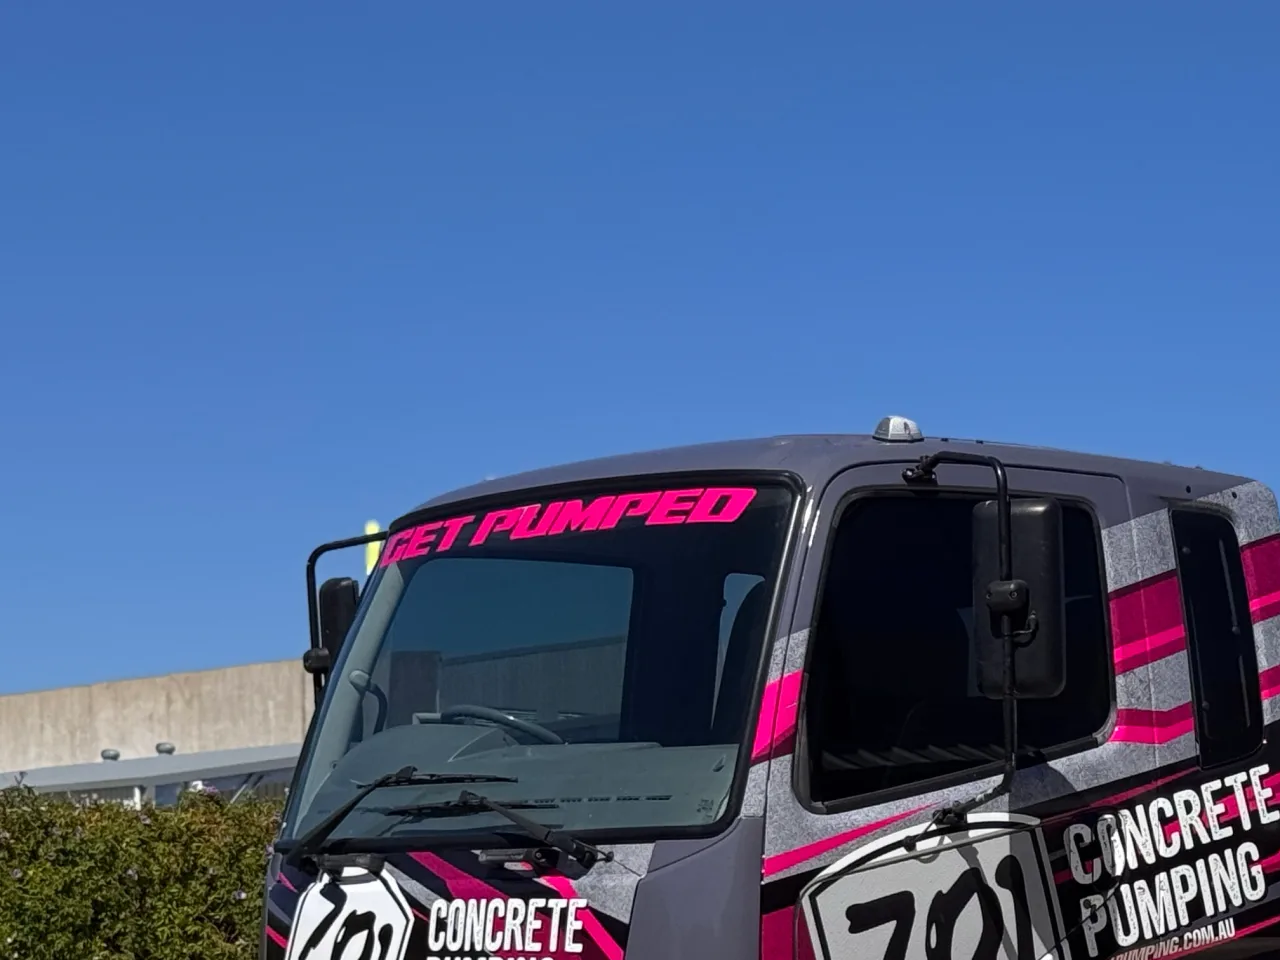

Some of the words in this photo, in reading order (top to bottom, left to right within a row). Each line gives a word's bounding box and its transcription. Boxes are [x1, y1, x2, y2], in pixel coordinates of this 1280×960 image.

[379, 515, 475, 568] GET
[468, 487, 758, 547] PUMPED
[1063, 764, 1280, 885] CONCRETE
[428, 898, 588, 953] CONCRETE
[1080, 841, 1266, 957] PUMPING
